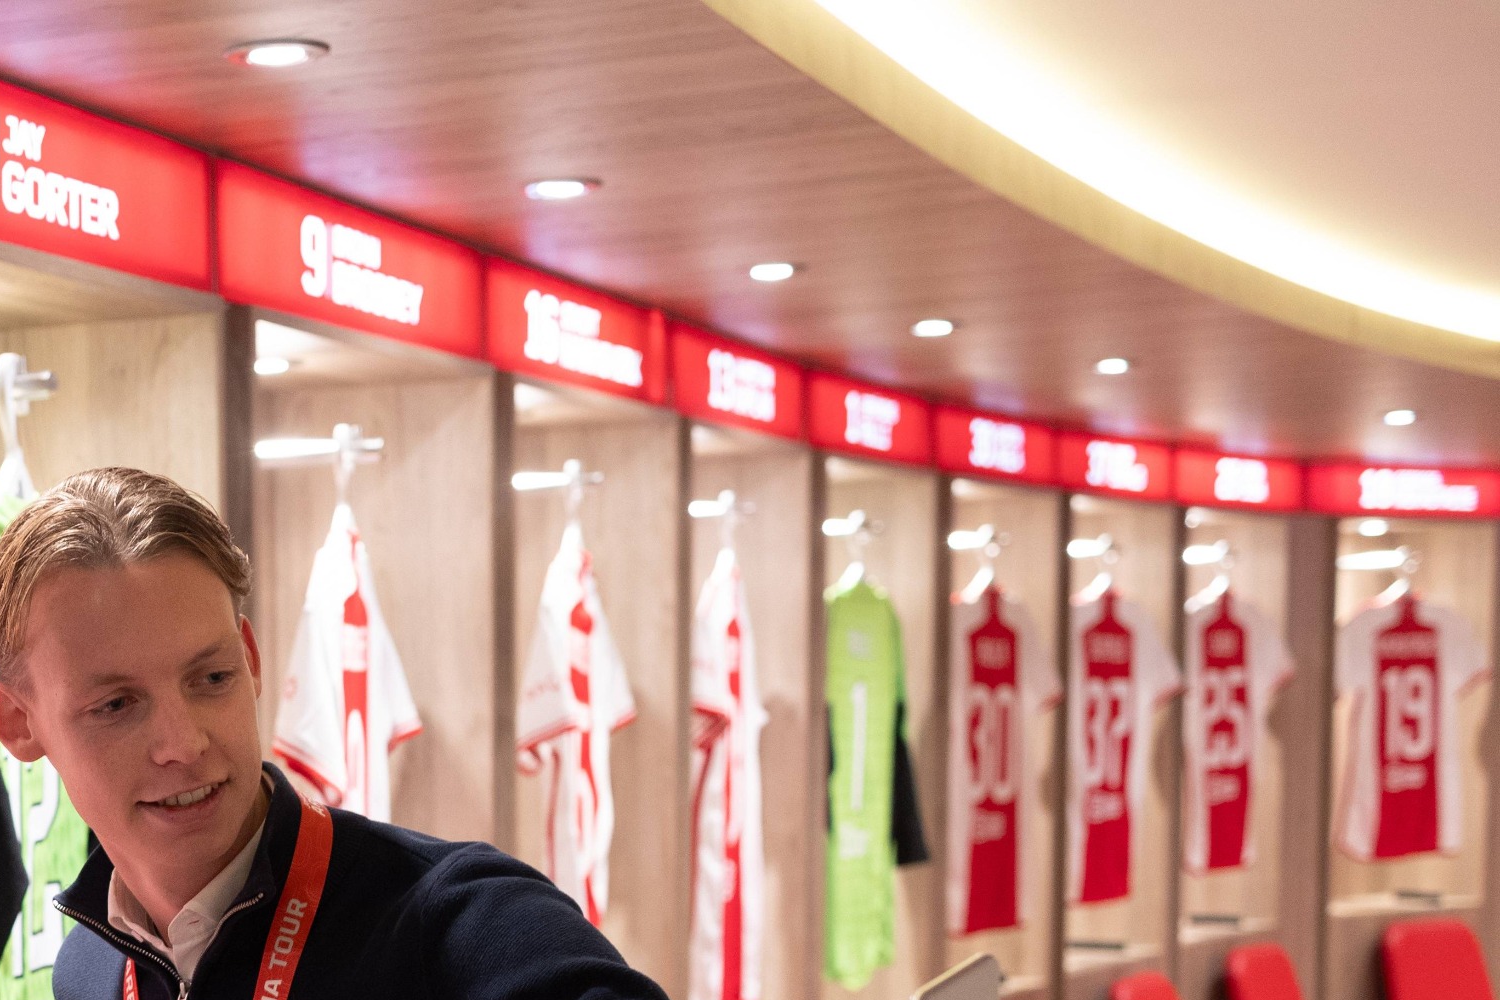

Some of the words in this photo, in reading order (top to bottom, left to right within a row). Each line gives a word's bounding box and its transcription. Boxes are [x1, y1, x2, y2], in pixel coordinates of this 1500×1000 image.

[1, 114, 46, 162] JAY
[1, 160, 120, 241] GORTER
[300, 214, 327, 298] 9
[1381, 664, 1435, 763] 19
[268, 897, 308, 972] TOUR
